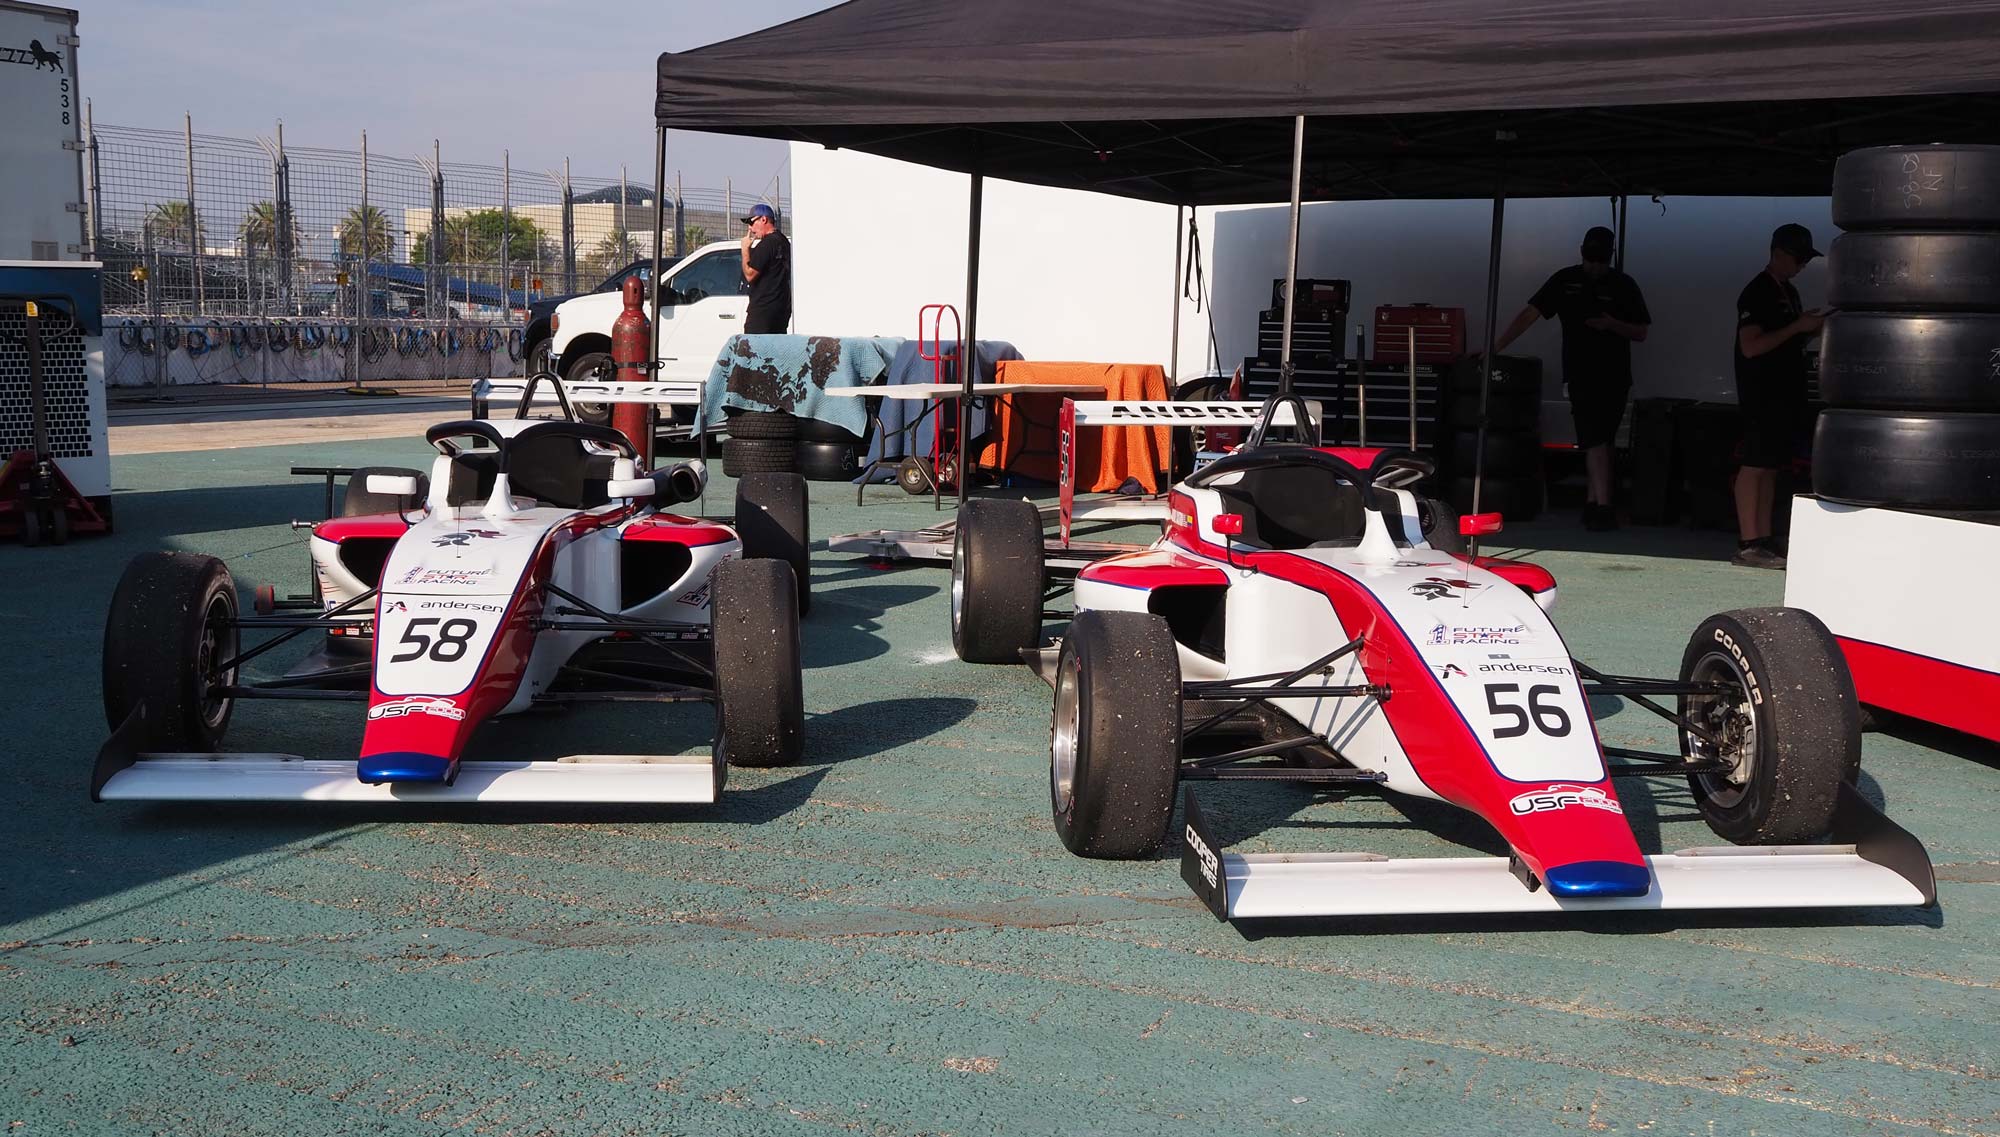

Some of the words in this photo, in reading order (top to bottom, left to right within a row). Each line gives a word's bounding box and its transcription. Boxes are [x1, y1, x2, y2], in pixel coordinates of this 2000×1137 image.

[60, 78, 70, 125] 538
[421, 600, 503, 613] andersen
[1453, 624, 1526, 632] FUTURE
[390, 617, 477, 663] 58
[1479, 662, 1571, 675] andersen
[1714, 628, 1764, 705] COOPER
[1484, 683, 1571, 739] 56
[1186, 824, 1219, 876] COOPER
[1200, 859, 1217, 889] TIRES
